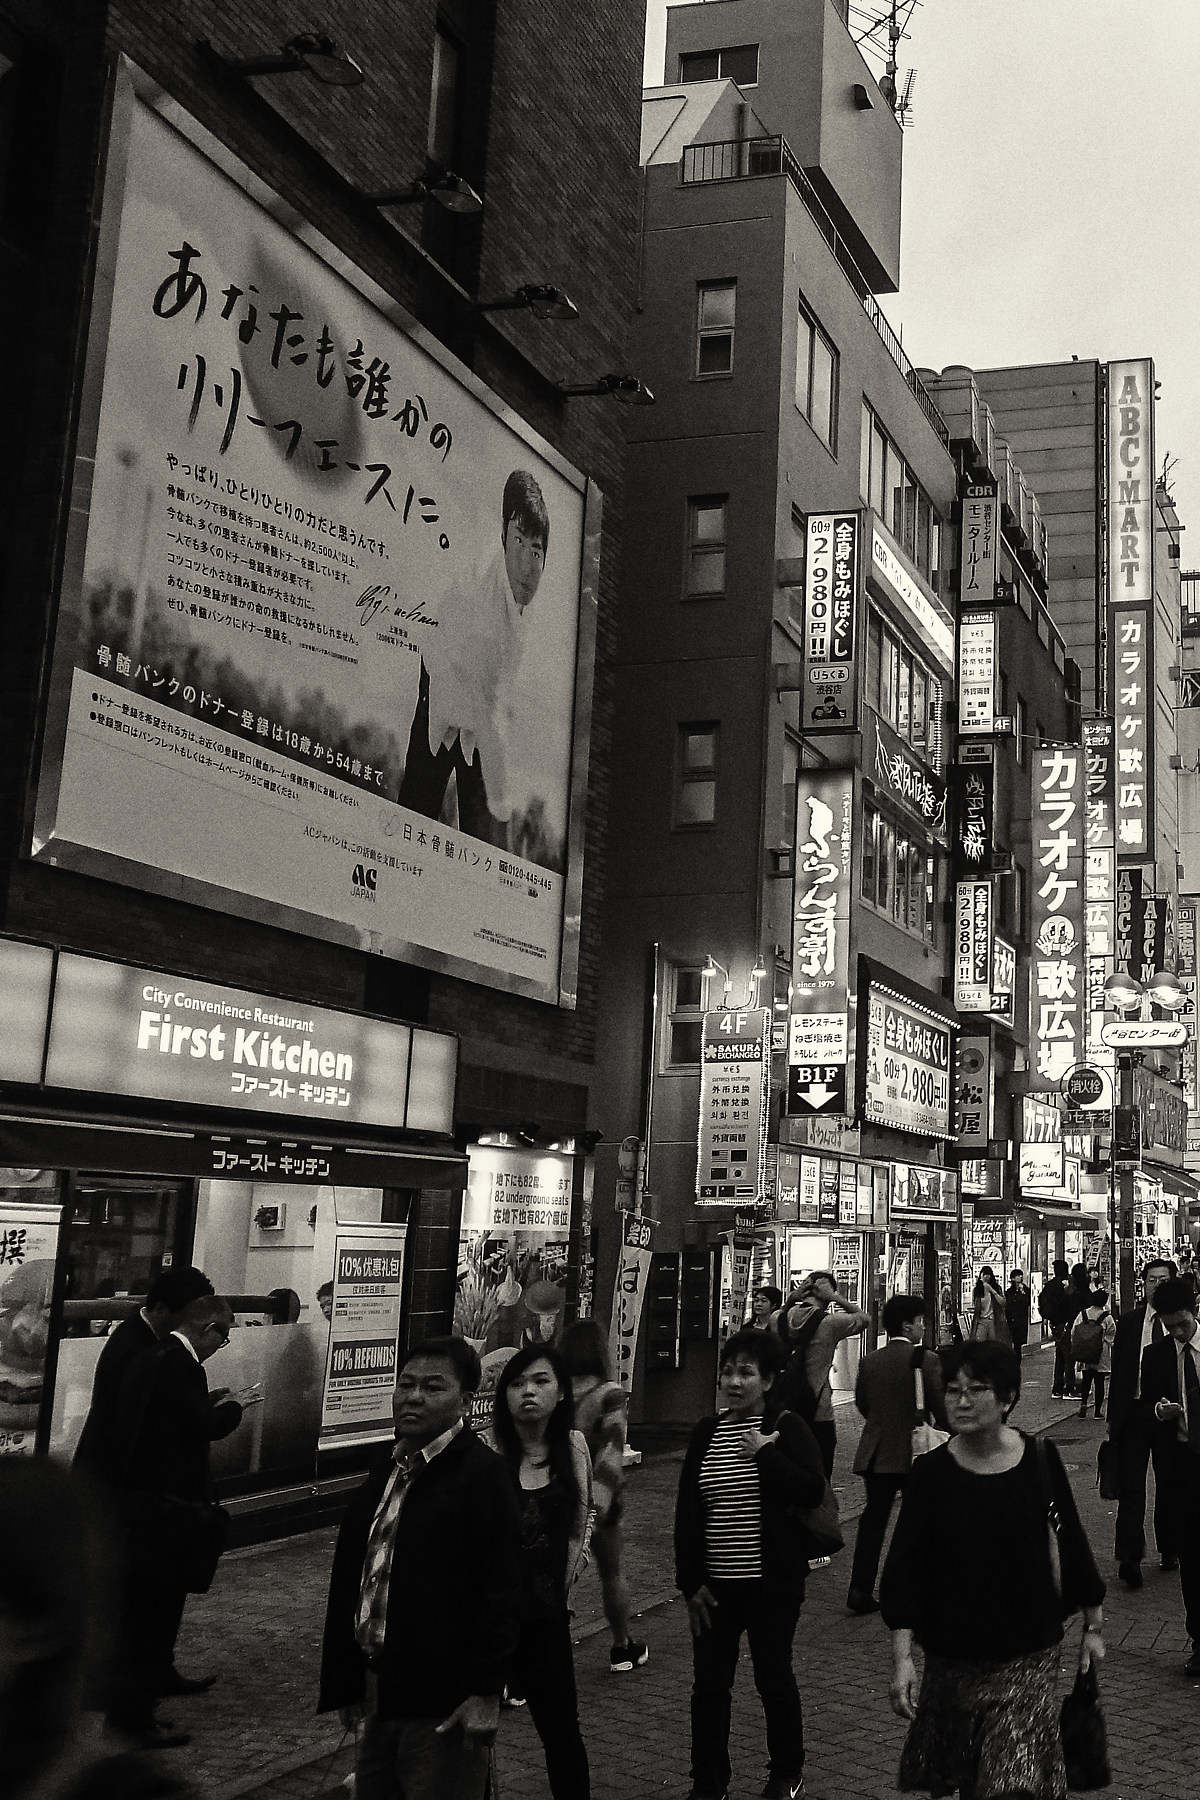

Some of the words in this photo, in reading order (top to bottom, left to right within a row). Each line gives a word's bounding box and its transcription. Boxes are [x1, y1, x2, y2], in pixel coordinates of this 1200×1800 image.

[152, 242, 452, 462] あなたも誰かの
[1118, 375, 1142, 588] ABC-MART
[166, 453, 390, 560] やっぱり、ひとりひとりの力だと思うんです。
[811, 521, 831, 534] 60分
[982, 503, 992, 559] 渋谷センター街
[966, 504, 981, 590] モニタールーム
[834, 522, 854, 657] 全身もみほぐし
[812, 669, 845, 681] りらくる
[816, 685, 842, 695] 渋谷店
[97, 644, 390, 790] 骨髄バンクのドナー登録は18歳から54歳まで。
[994, 719, 1010, 730] 4F
[1086, 755, 1108, 843] カラオケ
[1038, 751, 1078, 912] カラオケ
[403, 823, 492, 872] 日本骨髄バンク
[352, 864, 377, 891] AC
[796, 796, 839, 977] ふらんす亭
[351, 888, 377, 903] JAPAN
[974, 888, 987, 982] 全身もみほぐし
[797, 981, 816, 989] since
[818, 980, 835, 988] 1979
[142, 985, 172, 1008] City
[174, 992, 251, 1022] Convenience
[254, 1007, 314, 1033] Restaurant
[991, 996, 1008, 1009] 2F
[719, 1013, 748, 1034] 4F
[795, 1018, 844, 1028] レモンステーキ
[1036, 959, 1077, 1081] 歌広場
[137, 1010, 224, 1061] First
[233, 1025, 353, 1081] Kitchen
[717, 1044, 761, 1052] SAKURA
[885, 1010, 947, 1066] 全身もみほぐし
[798, 1066, 838, 1083] B1F
[884, 1057, 900, 1079] 60分
[231, 1072, 296, 1099] ファースト
[299, 1083, 351, 1107] キッチン
[1070, 1079, 1102, 1095] 消火栓
[958, 1082, 983, 1135] 松屋
[212, 1150, 276, 1172] ファースト
[279, 1154, 331, 1177] キッチン
[494, 1191, 504, 1202] 82
[506, 1191, 550, 1207] underground
[551, 1194, 569, 1206] seats
[341, 1256, 361, 1277] 10%
[333, 1348, 353, 1371] 10%
[354, 1345, 395, 1370] REFUNDS
